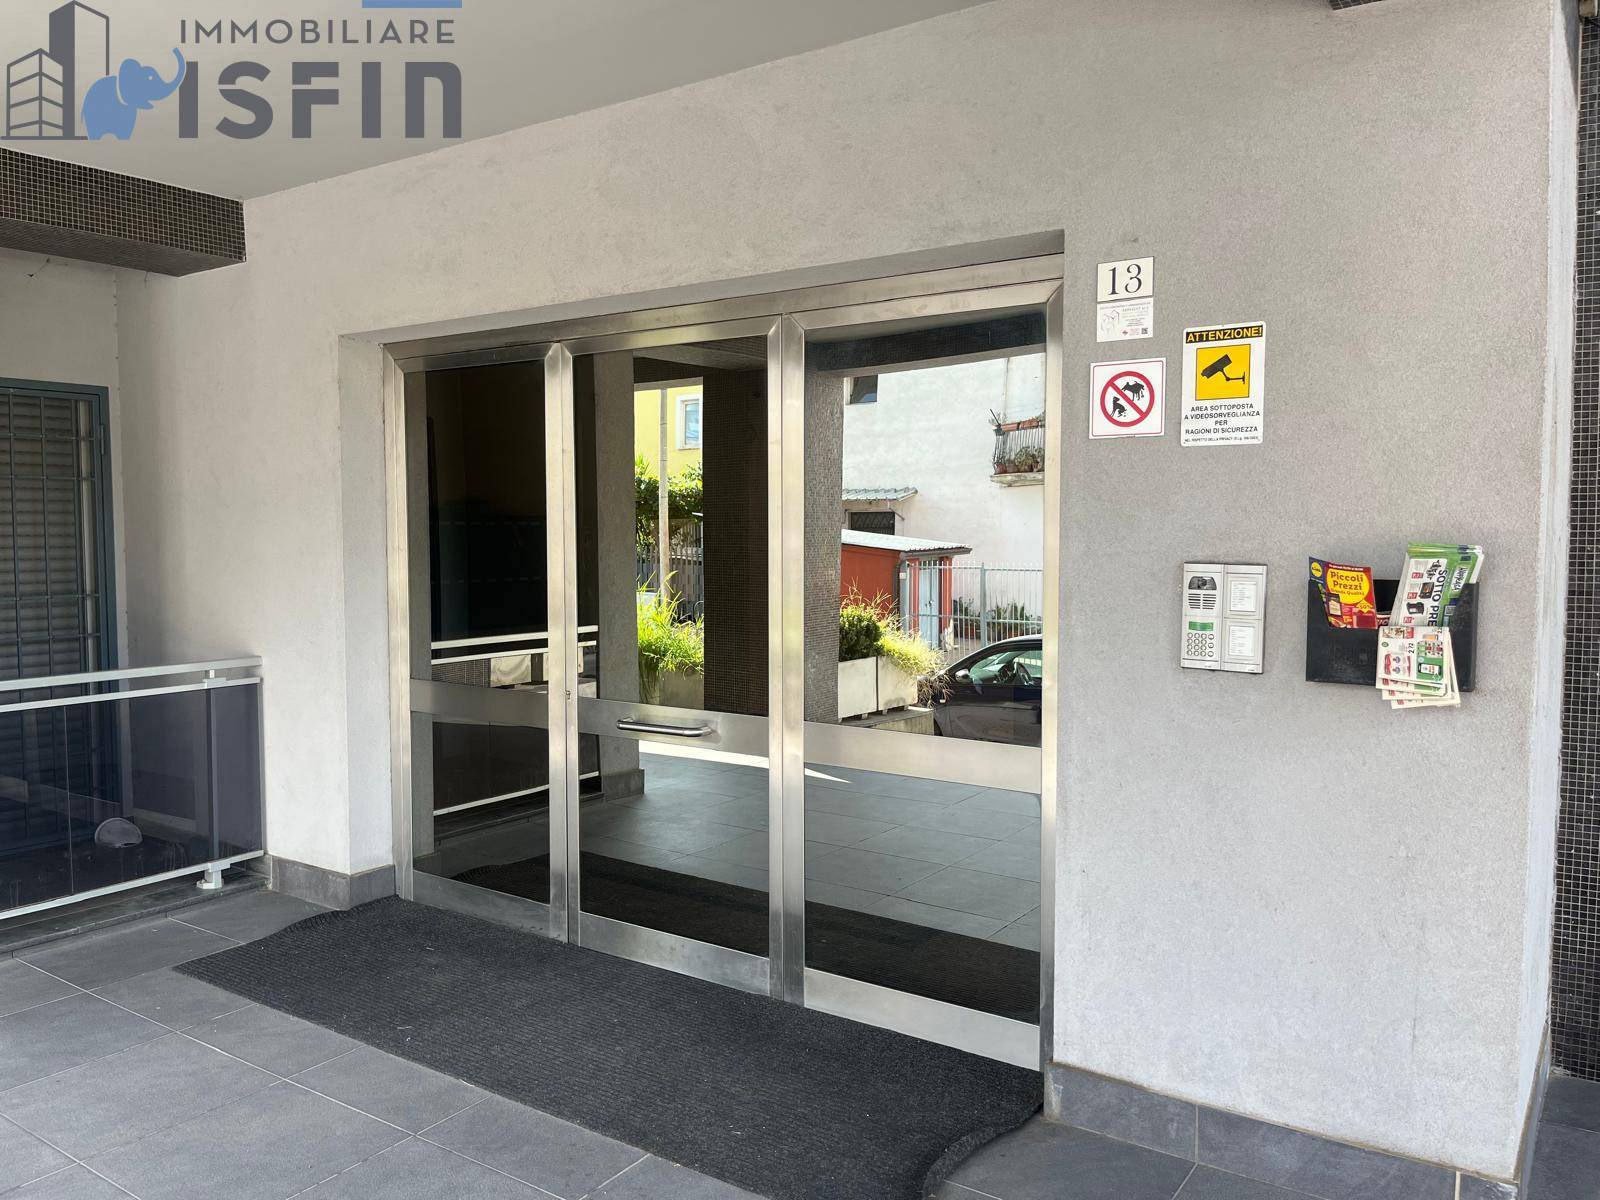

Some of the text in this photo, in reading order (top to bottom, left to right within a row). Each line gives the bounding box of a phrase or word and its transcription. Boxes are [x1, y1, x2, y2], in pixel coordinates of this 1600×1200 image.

[1107, 263, 1142, 295] 13
[1186, 326, 1262, 342] ATTENZIONE!
[1210, 403, 1254, 411] SOTTOPOSTA
[1190, 410, 1260, 420] VIDEOSORVEGLIANZA
[1330, 571, 1363, 582] Piccoli
[1333, 580, 1362, 591] Prezzi
[1431, 569, 1448, 602] SOTTO
